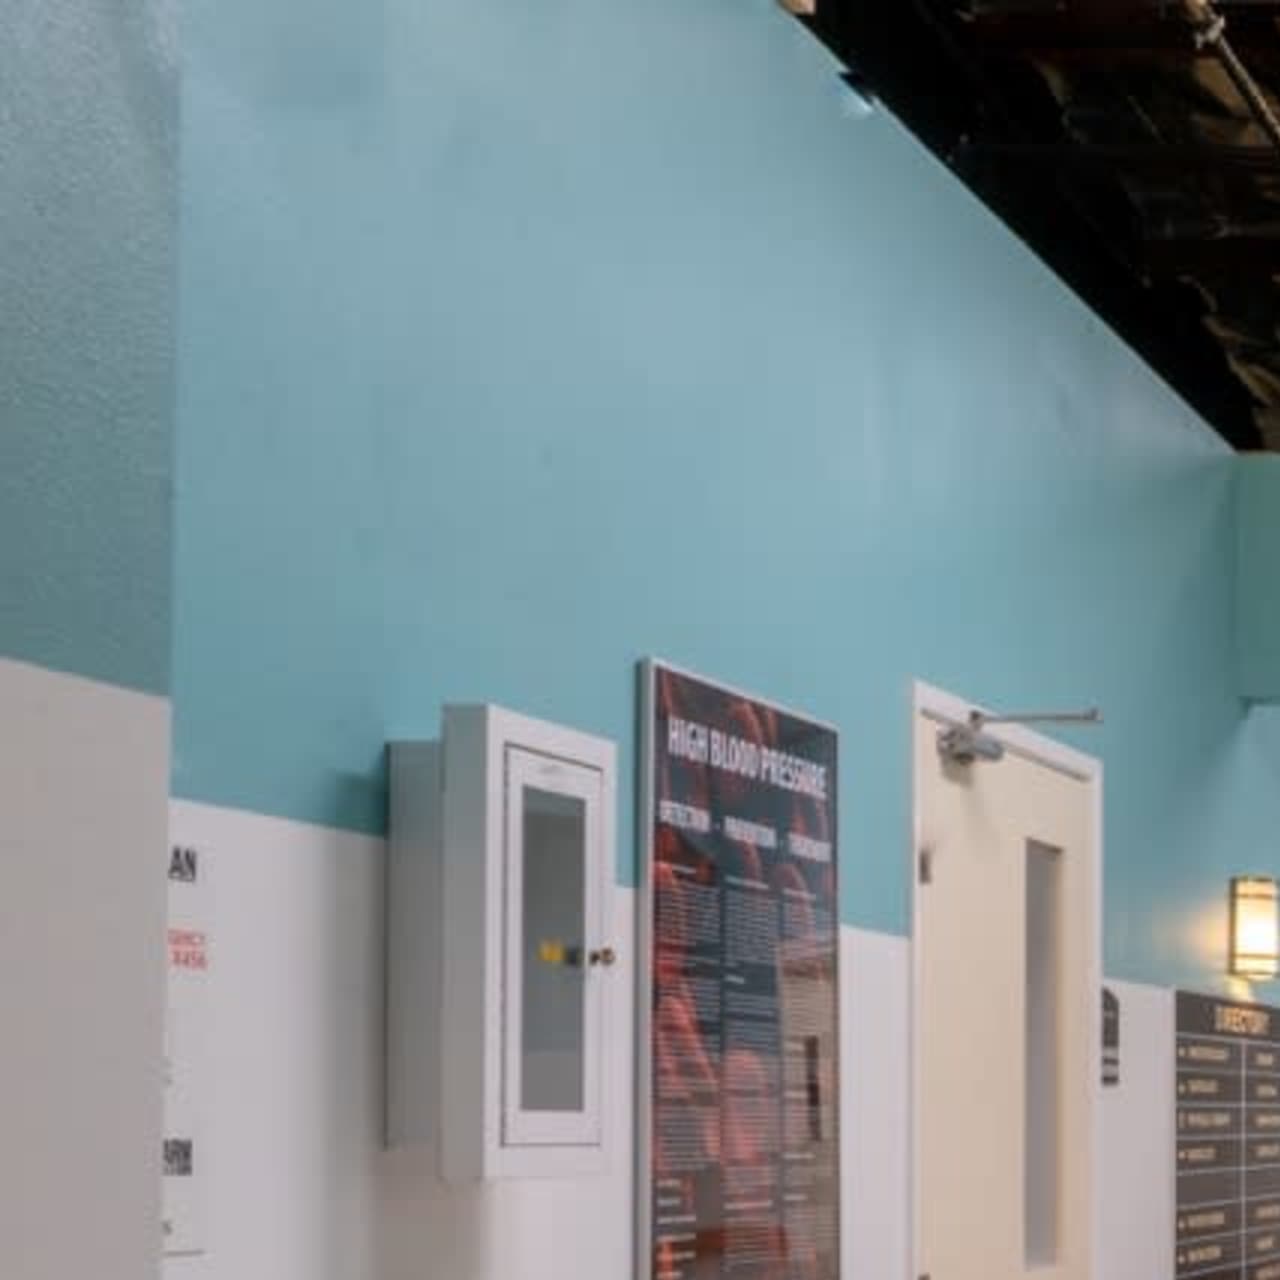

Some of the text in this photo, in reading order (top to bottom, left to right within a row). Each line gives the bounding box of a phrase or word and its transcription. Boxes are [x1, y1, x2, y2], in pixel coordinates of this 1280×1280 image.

[668, 715, 827, 800] HIGH BLOOD PRESSURE
